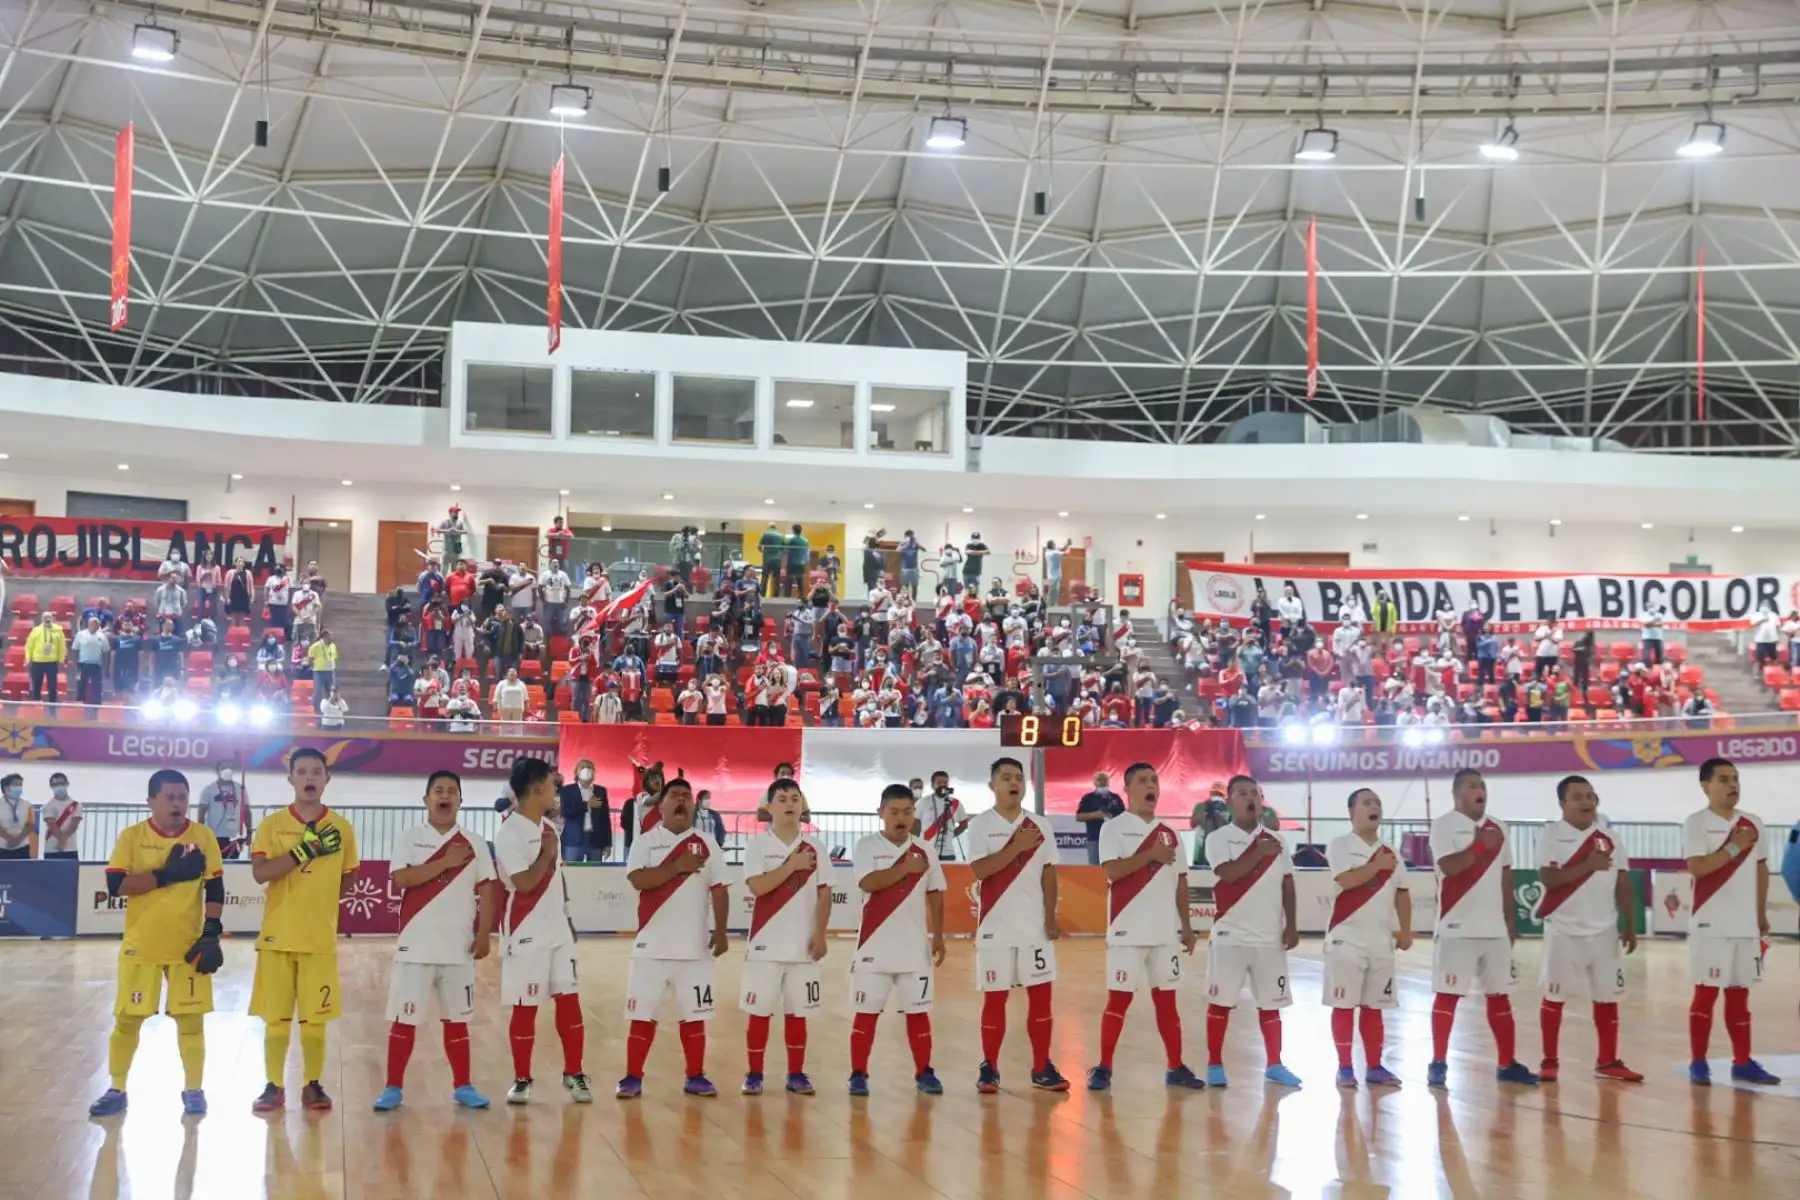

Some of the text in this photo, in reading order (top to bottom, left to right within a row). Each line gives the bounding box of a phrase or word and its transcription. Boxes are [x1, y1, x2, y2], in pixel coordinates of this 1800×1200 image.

[1470, 580, 1520, 621] DE
[1535, 579, 1585, 620] LA
[1599, 576, 1780, 620] BICOLOR
[1021, 715, 1080, 746] 8 0
[1269, 751, 1389, 772] SEGUIMOS
[1034, 948, 1046, 970] 5
[1171, 955, 1180, 976] 3
[187, 976, 195, 998] 1
[319, 985, 331, 1008] 2
[693, 983, 714, 1008] 14
[805, 980, 820, 1004] 10
[919, 976, 929, 1000] 7
[1277, 975, 1286, 996] 9
